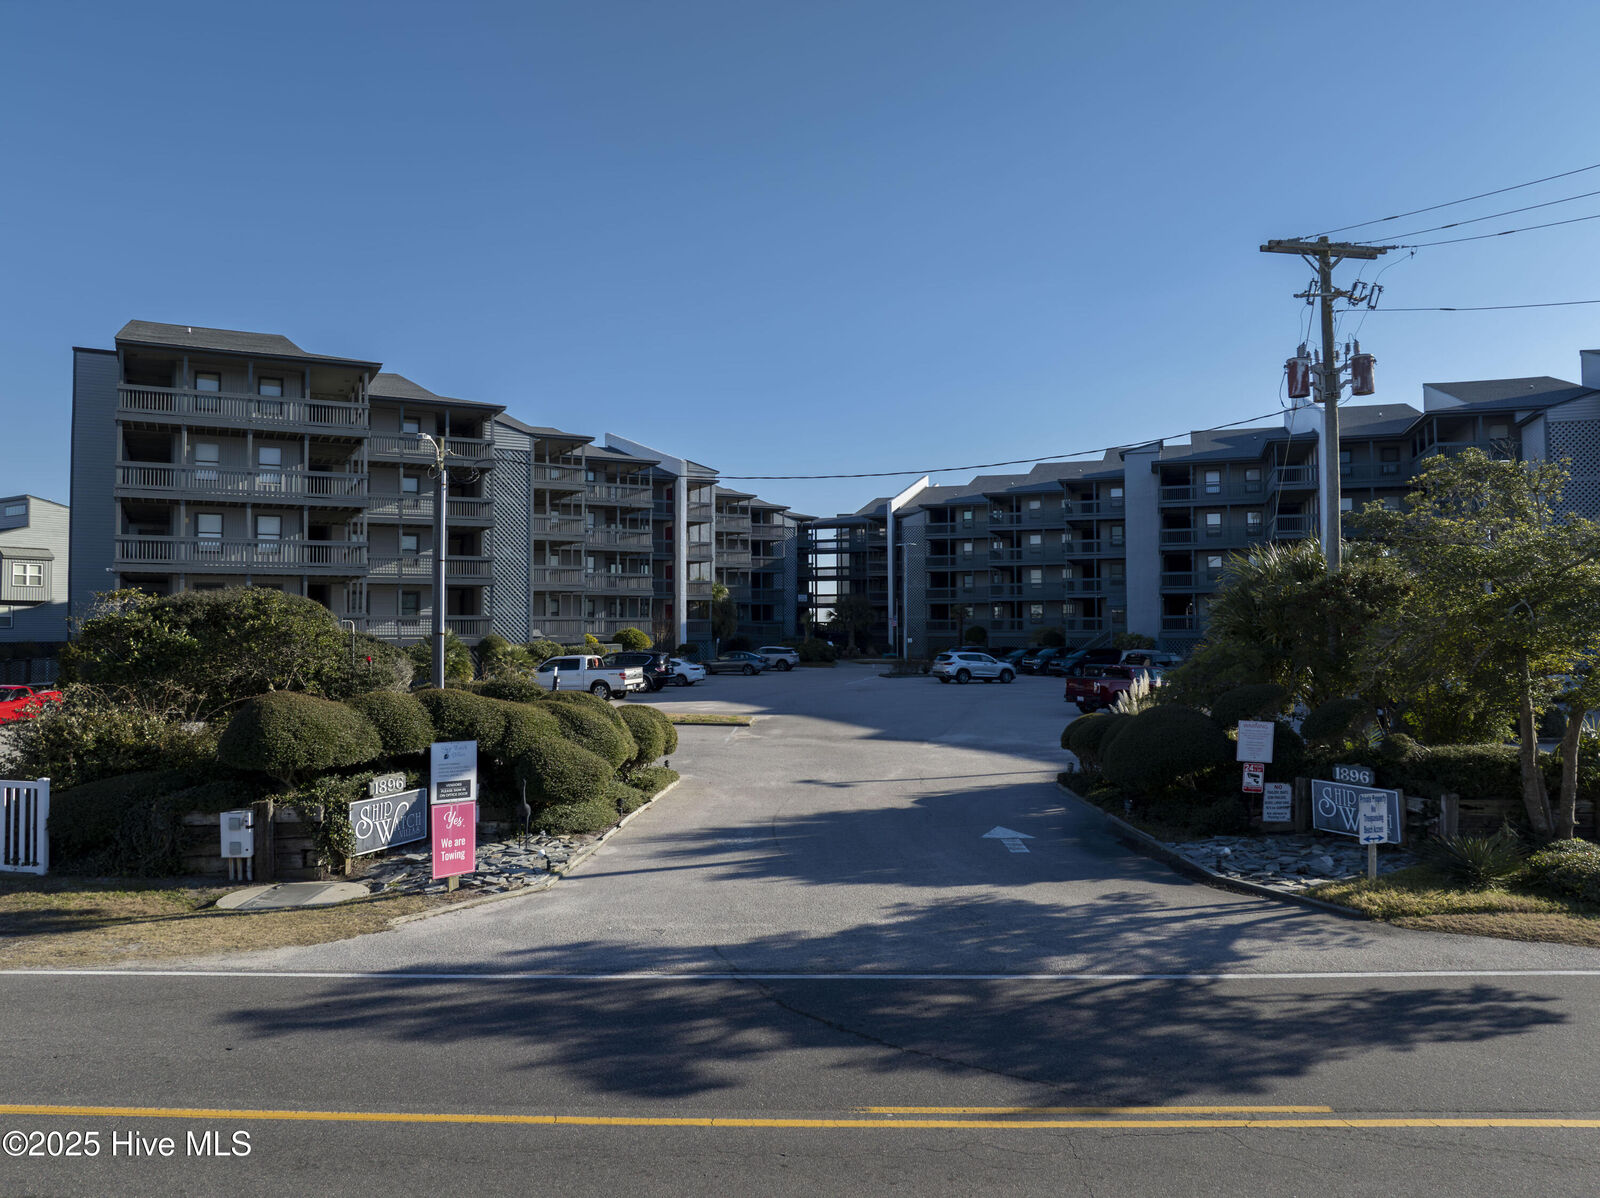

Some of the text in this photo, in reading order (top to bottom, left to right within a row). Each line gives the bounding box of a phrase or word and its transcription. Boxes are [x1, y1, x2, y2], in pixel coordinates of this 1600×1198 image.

[1335, 767, 1370, 784] 1896
[374, 776, 404, 795] 1896
[1318, 786, 1357, 818] SHIP
[355, 800, 393, 839] SHIP
[373, 801, 422, 844] WATCH
[441, 837, 466, 849] We are
[441, 849, 466, 862] Towing
